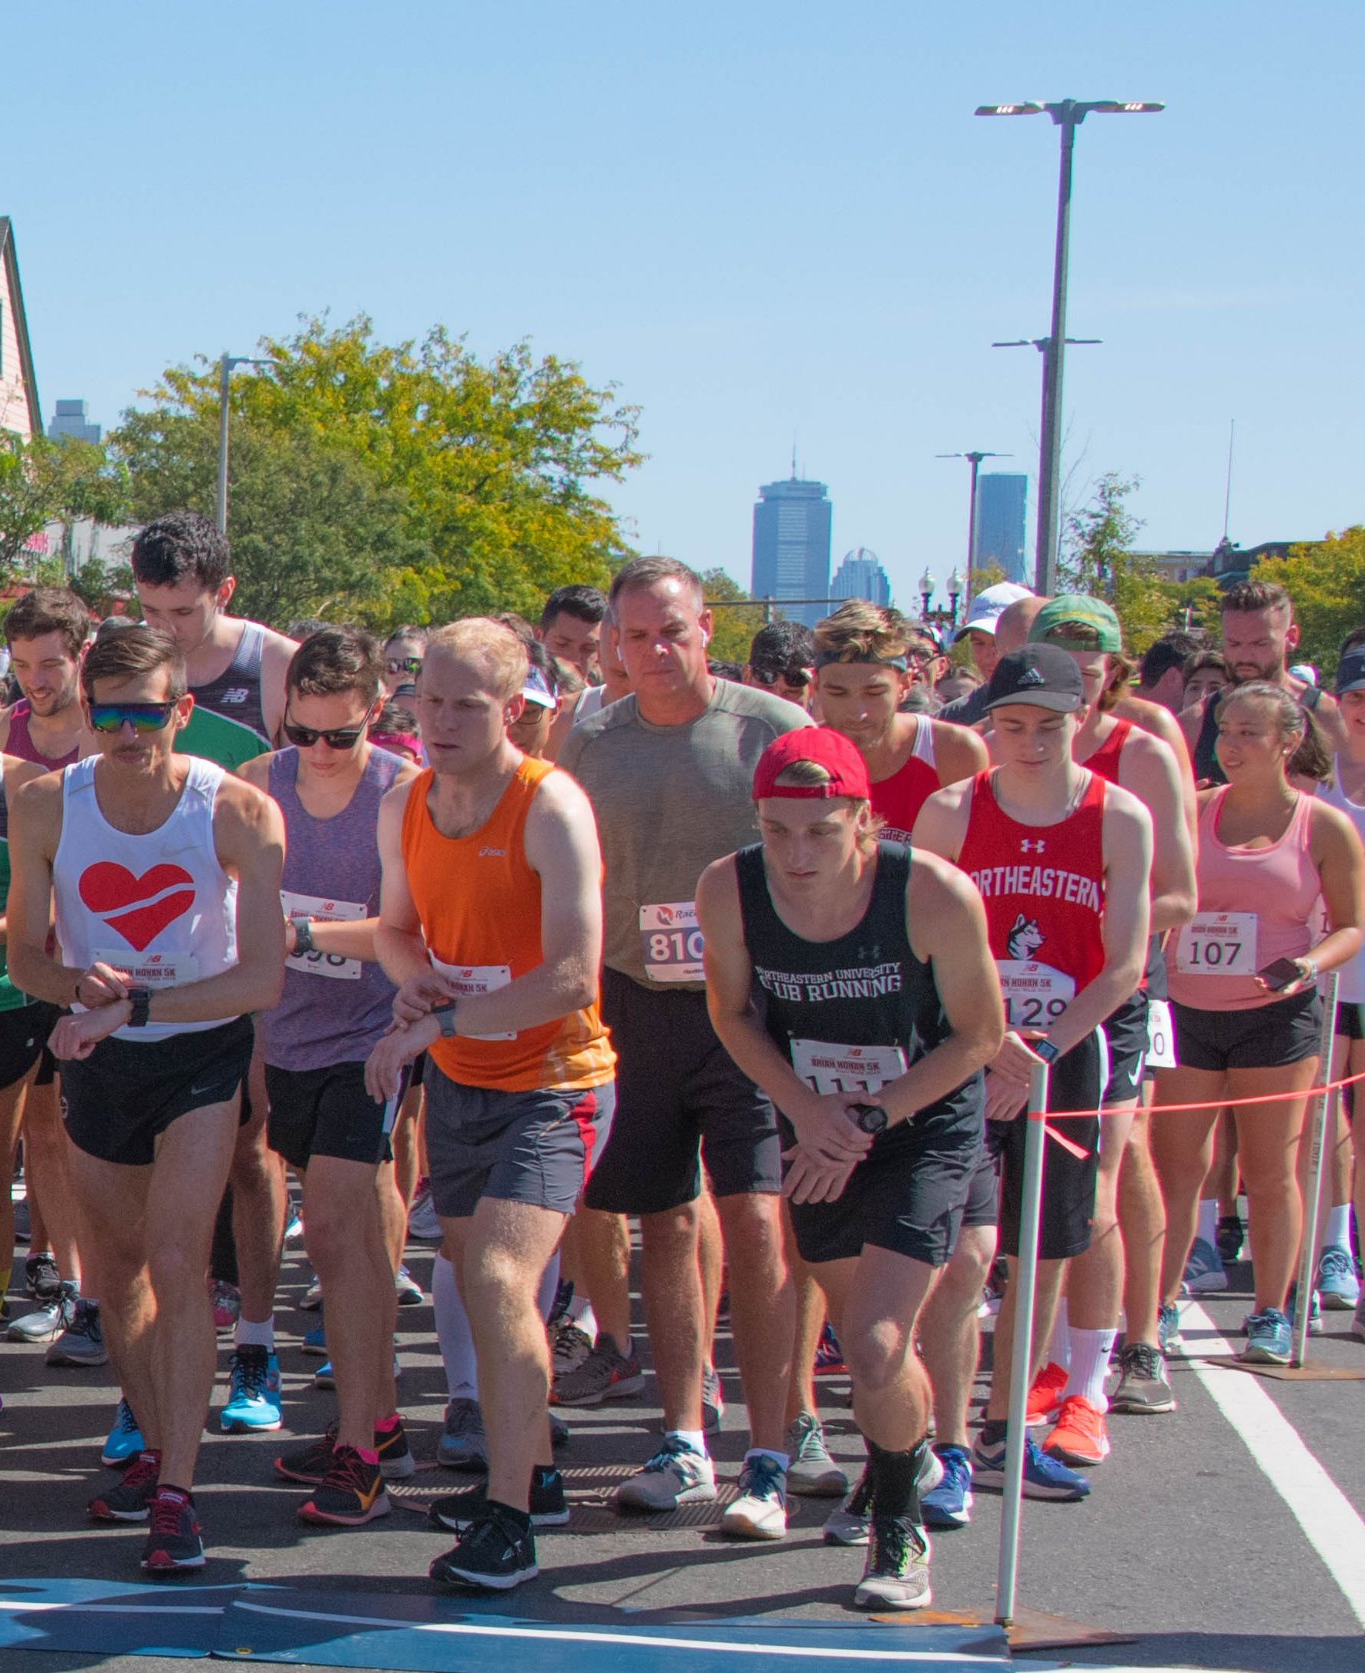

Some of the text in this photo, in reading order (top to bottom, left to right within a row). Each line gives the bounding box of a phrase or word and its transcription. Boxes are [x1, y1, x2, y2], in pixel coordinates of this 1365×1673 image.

[970, 865, 1101, 913] ORTHEASTERN
[1189, 941, 1242, 966] 107
[135, 968, 162, 977] HONAN
[164, 968, 176, 977] 5K
[835, 962, 901, 980] UNIVERSITY
[475, 984, 487, 993] 5K
[1040, 978, 1052, 987] 5K
[811, 1058, 880, 1071] BRIAN HONAN 5K
